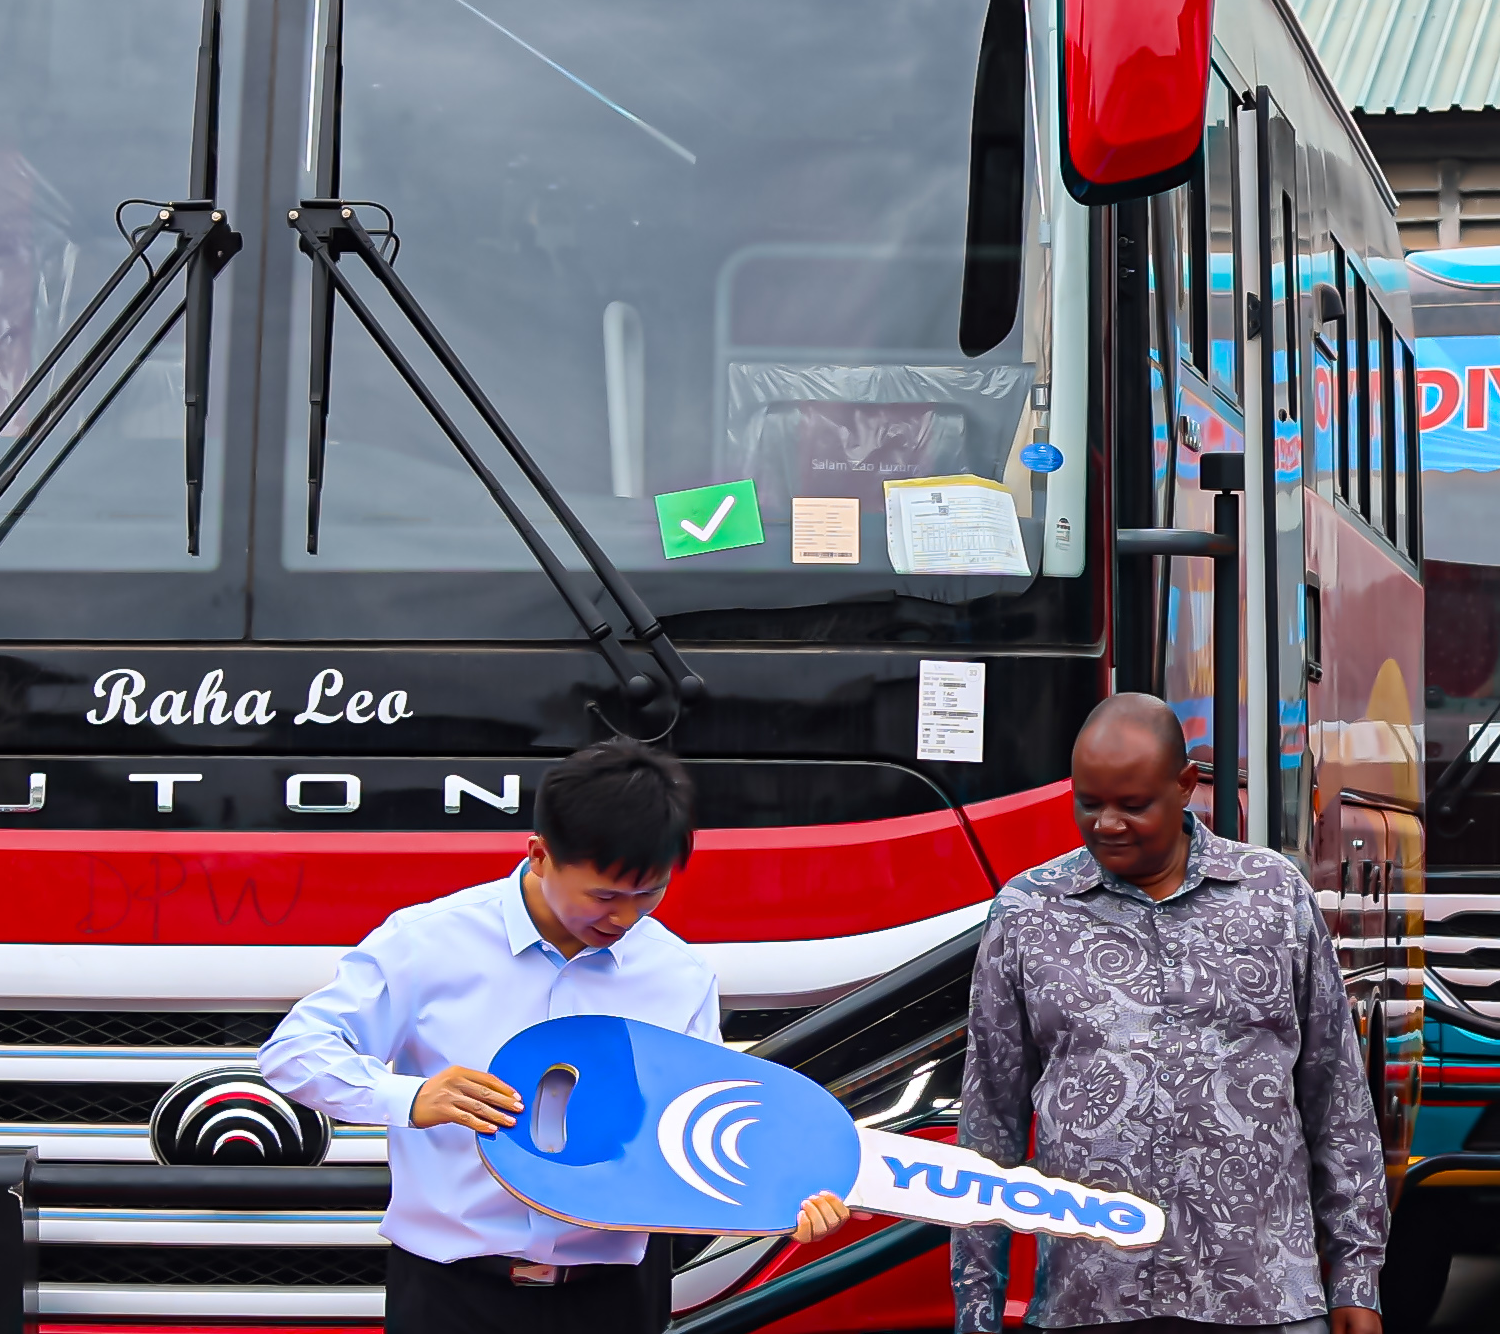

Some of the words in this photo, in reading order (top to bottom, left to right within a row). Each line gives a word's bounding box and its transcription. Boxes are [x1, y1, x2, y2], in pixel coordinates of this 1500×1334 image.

[86, 668, 277, 726] Raha
[293, 668, 414, 726] Leo
[881, 1155, 1146, 1234] YUTONG
